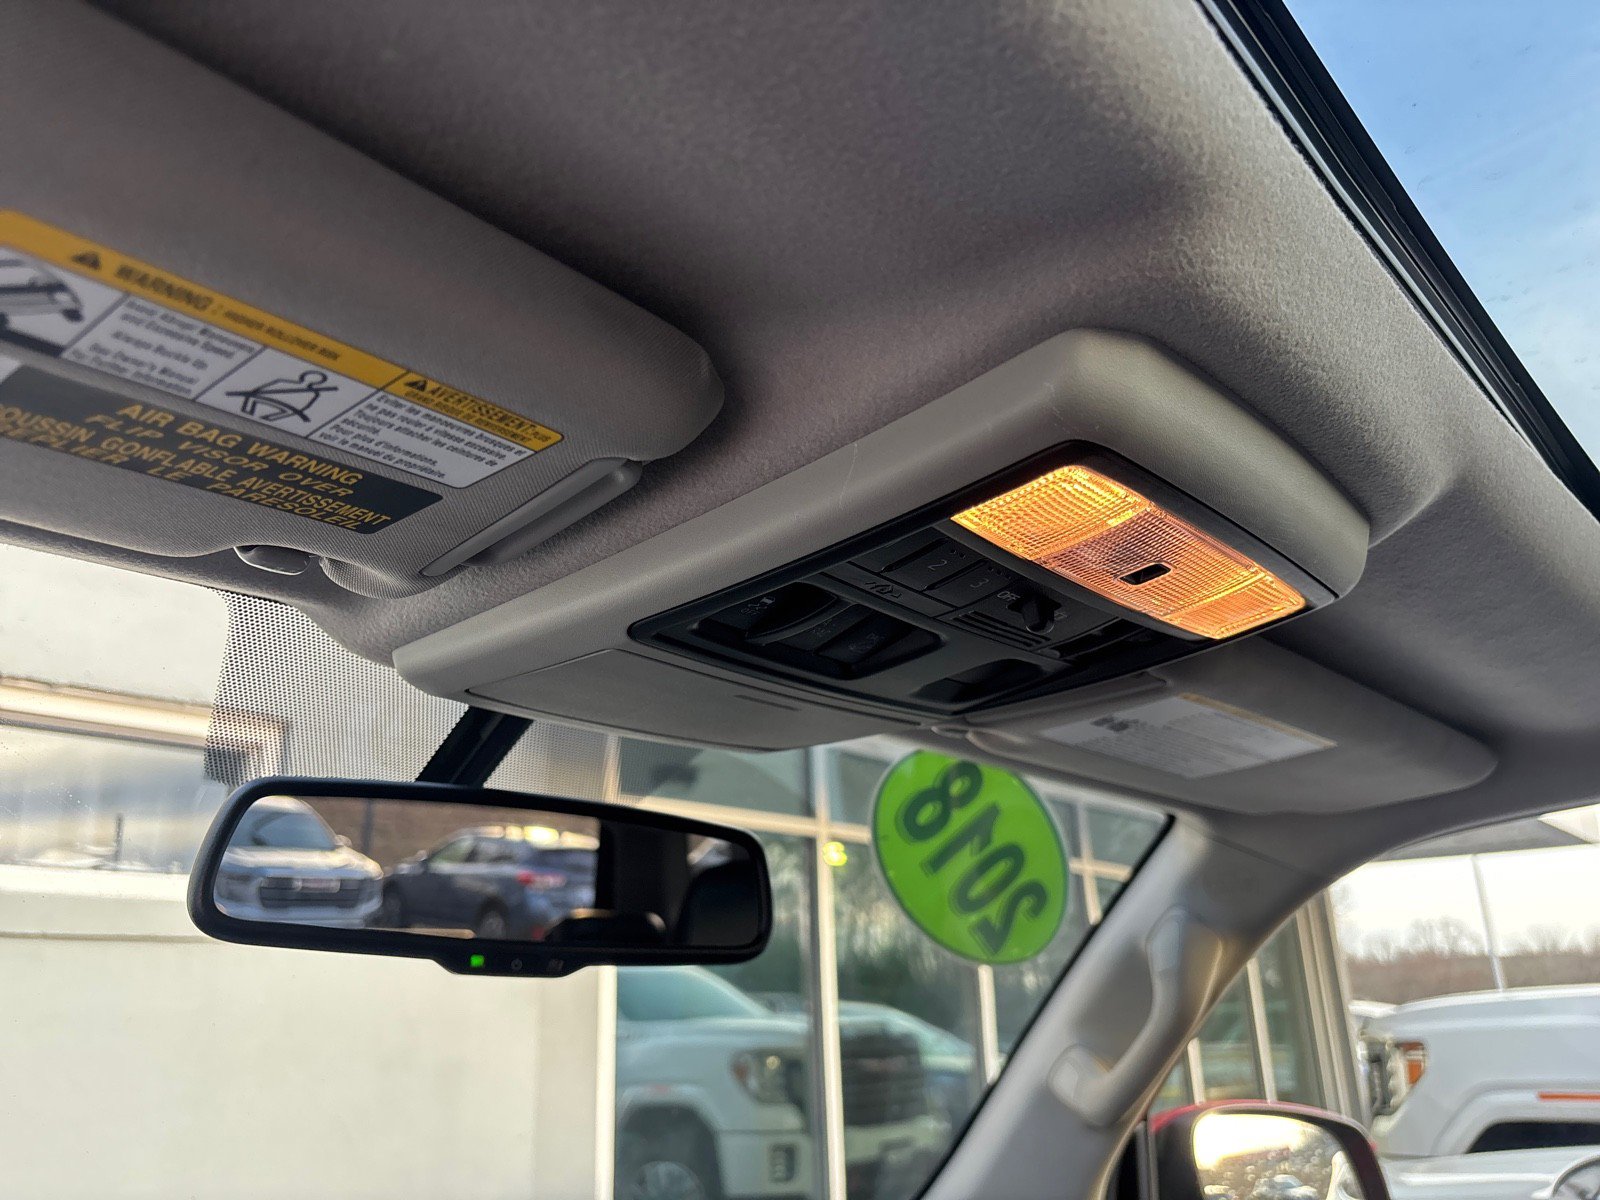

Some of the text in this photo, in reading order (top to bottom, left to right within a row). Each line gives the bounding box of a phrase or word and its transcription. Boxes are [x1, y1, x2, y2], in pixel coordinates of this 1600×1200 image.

[0, 403, 96, 443] OUSSIN
[236, 476, 392, 527] AVERTISSEMENT
[84, 414, 355, 498] FLIP VISOR OVER
[115, 403, 363, 486] AIR BAG WARNING
[148, 466, 193, 482] LE
[207, 482, 362, 531] PARESOLEIL
[927, 558, 948, 571] 2
[969, 577, 990, 589] 3
